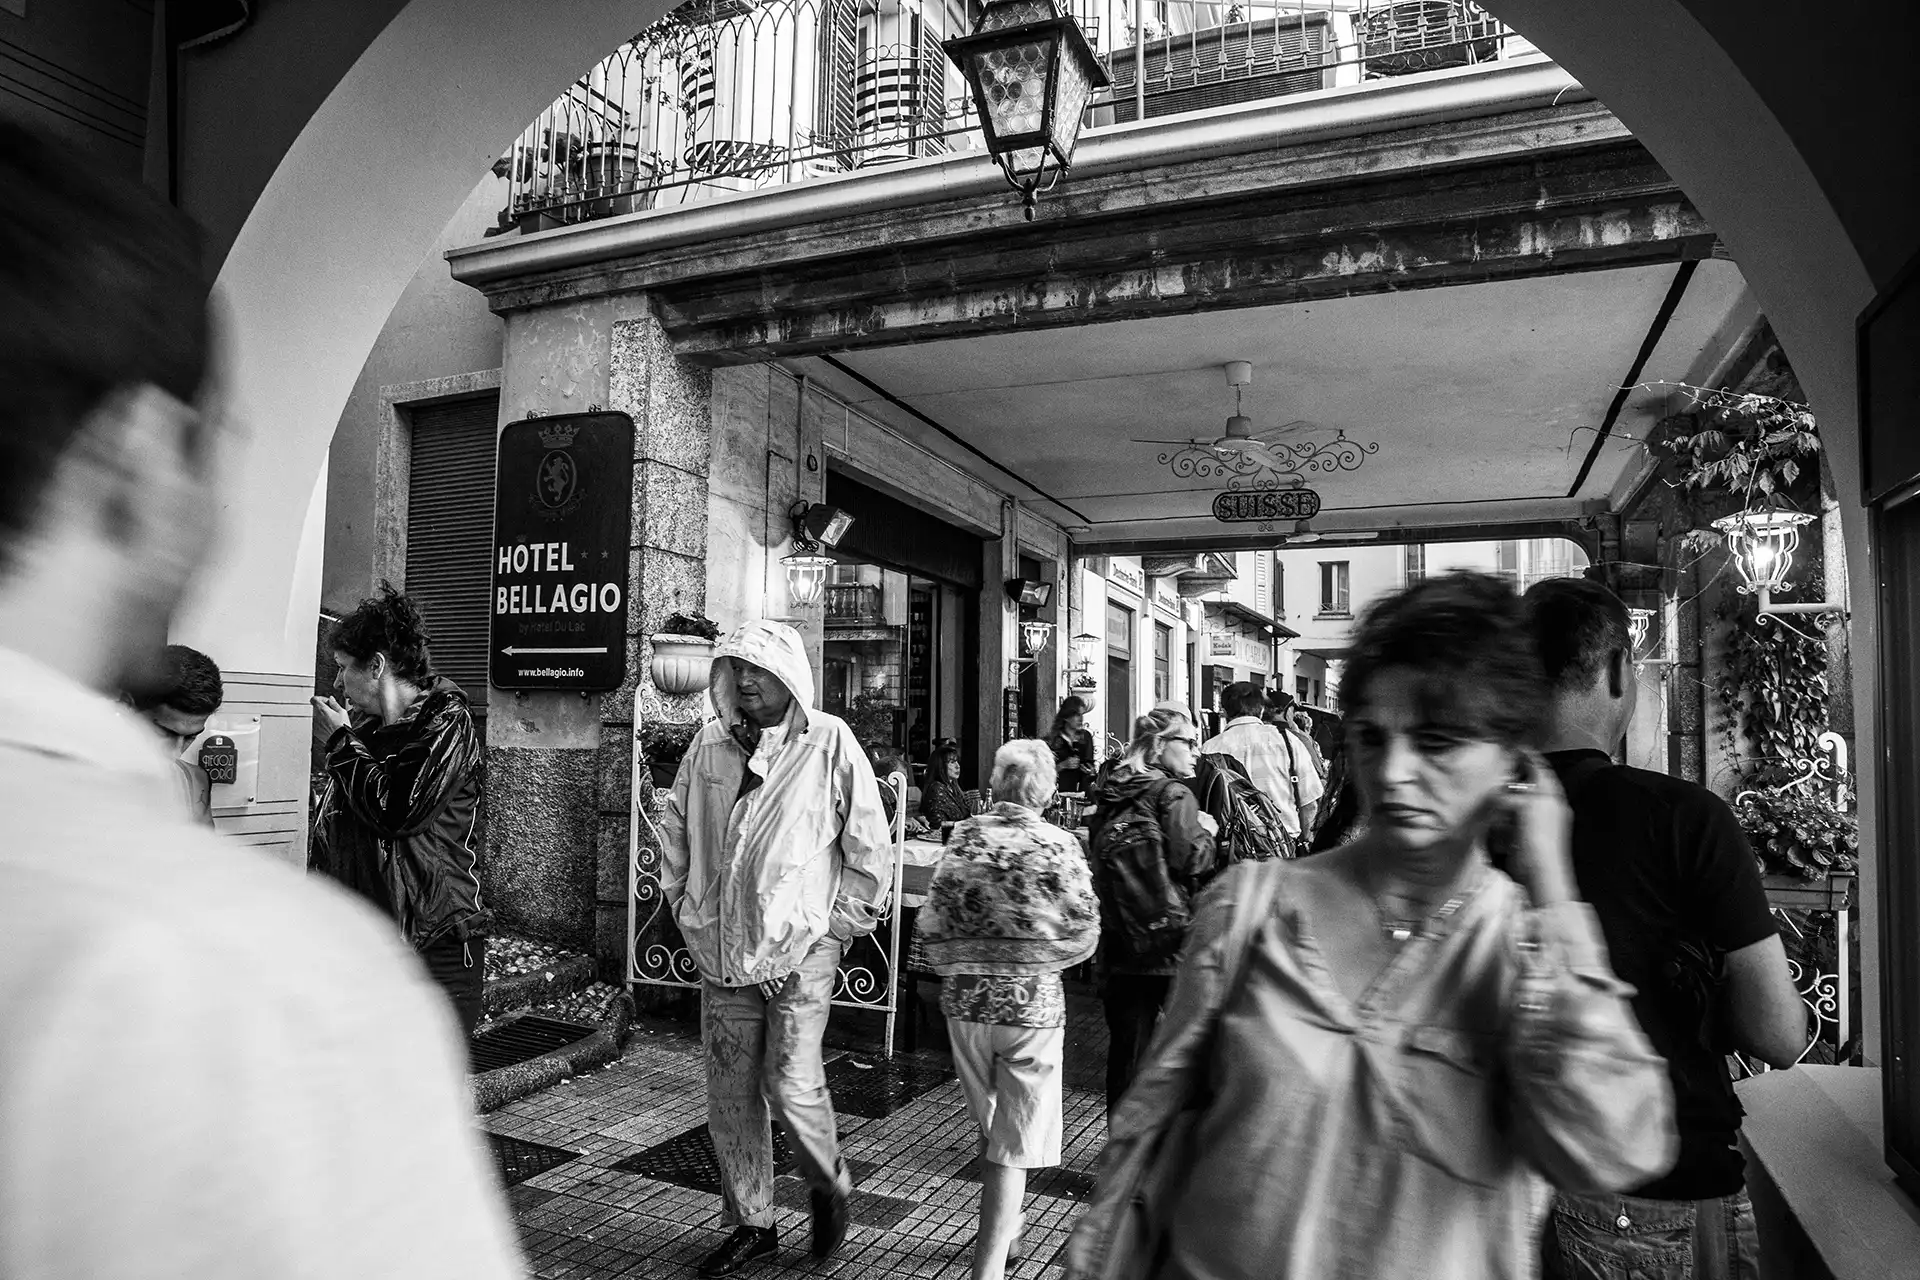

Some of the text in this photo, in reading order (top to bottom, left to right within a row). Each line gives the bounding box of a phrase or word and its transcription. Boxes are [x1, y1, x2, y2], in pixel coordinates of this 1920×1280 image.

[1217, 492, 1314, 519] SUISSE
[498, 542, 574, 574] HOTEL
[496, 582, 621, 615] BELLAGIO
[568, 620, 586, 632] Lac
[517, 667, 585, 679] www.bellagio.info
